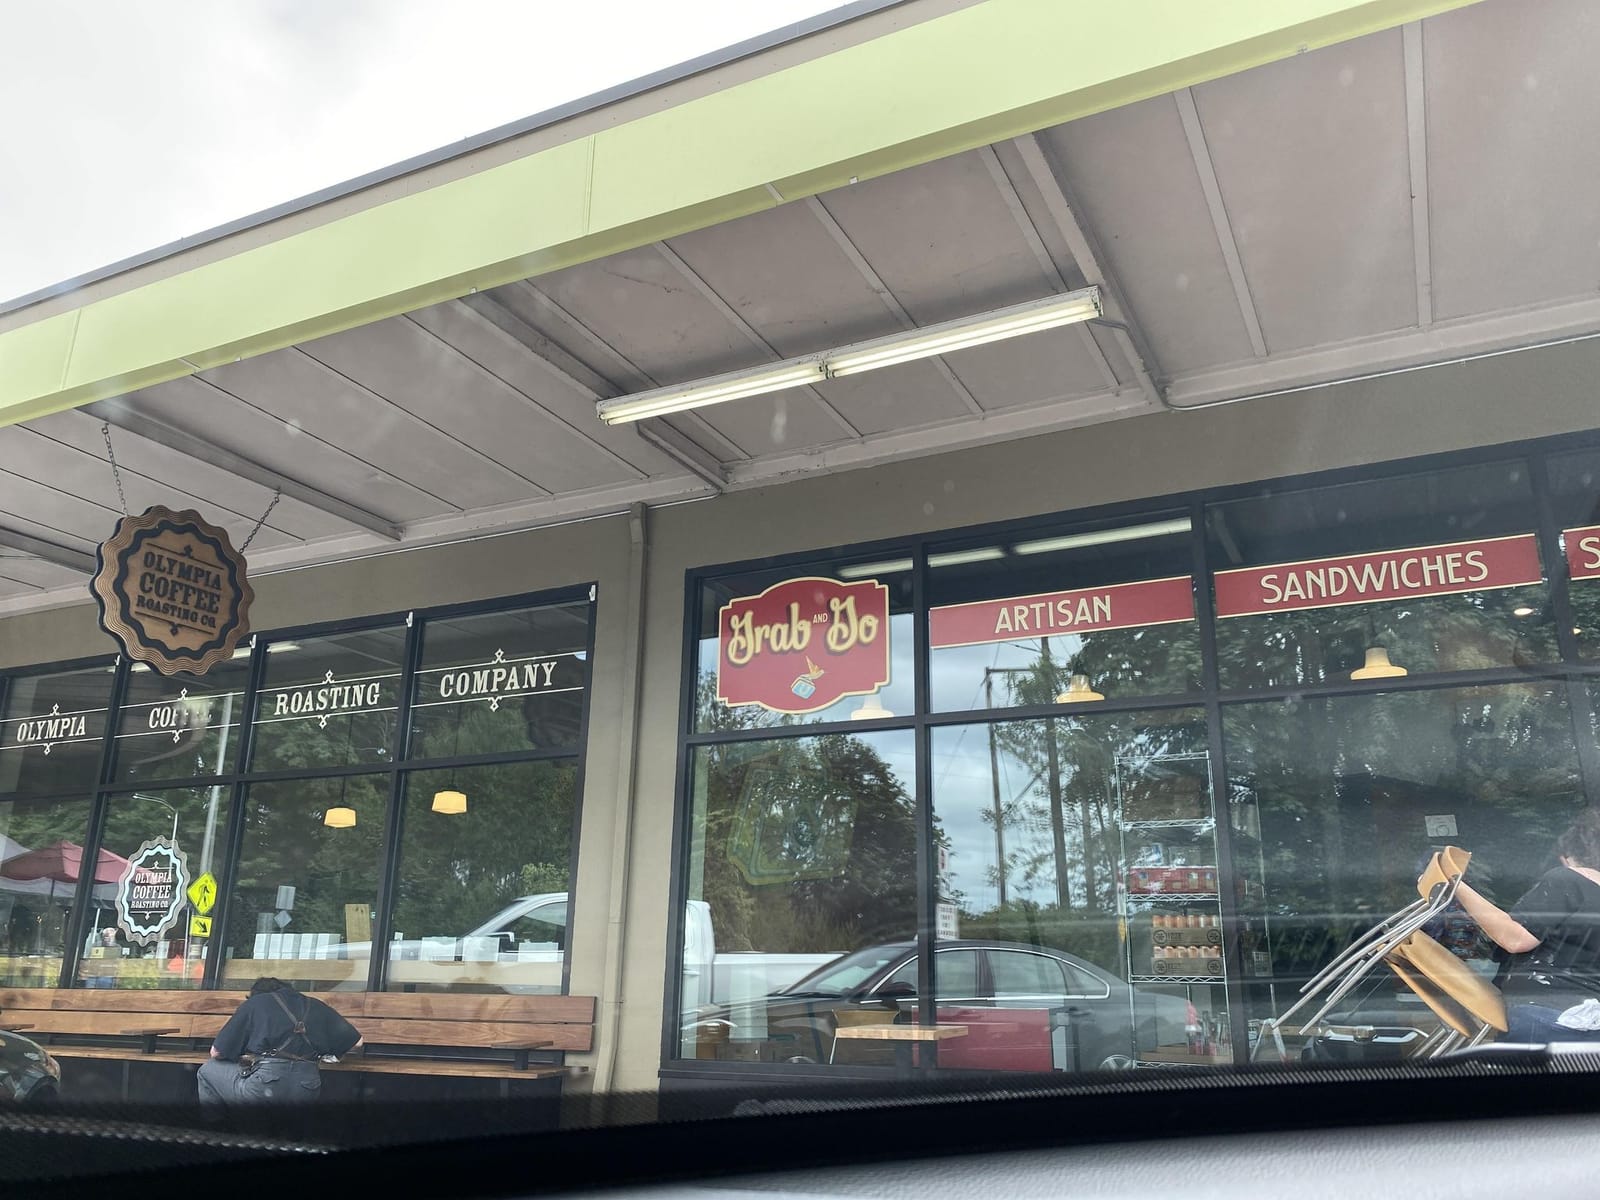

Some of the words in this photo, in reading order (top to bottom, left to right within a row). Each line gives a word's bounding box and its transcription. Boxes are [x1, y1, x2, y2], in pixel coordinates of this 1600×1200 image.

[143, 551, 221, 590] OLYMPIA
[136, 595, 198, 622] ROASTING
[139, 573, 220, 614] COFFEE
[994, 594, 1112, 634] ARTISAN
[1259, 550, 1489, 604] SANDWICHES
[727, 602, 812, 665] Grab
[812, 612, 829, 624] AND
[827, 595, 880, 651] Go
[16, 715, 86, 742] OLYMPIA
[273, 682, 381, 716] ROASTING
[440, 661, 557, 698] COMPANY
[133, 885, 171, 898] COFFEE
[136, 872, 172, 883] OLYMPIA
